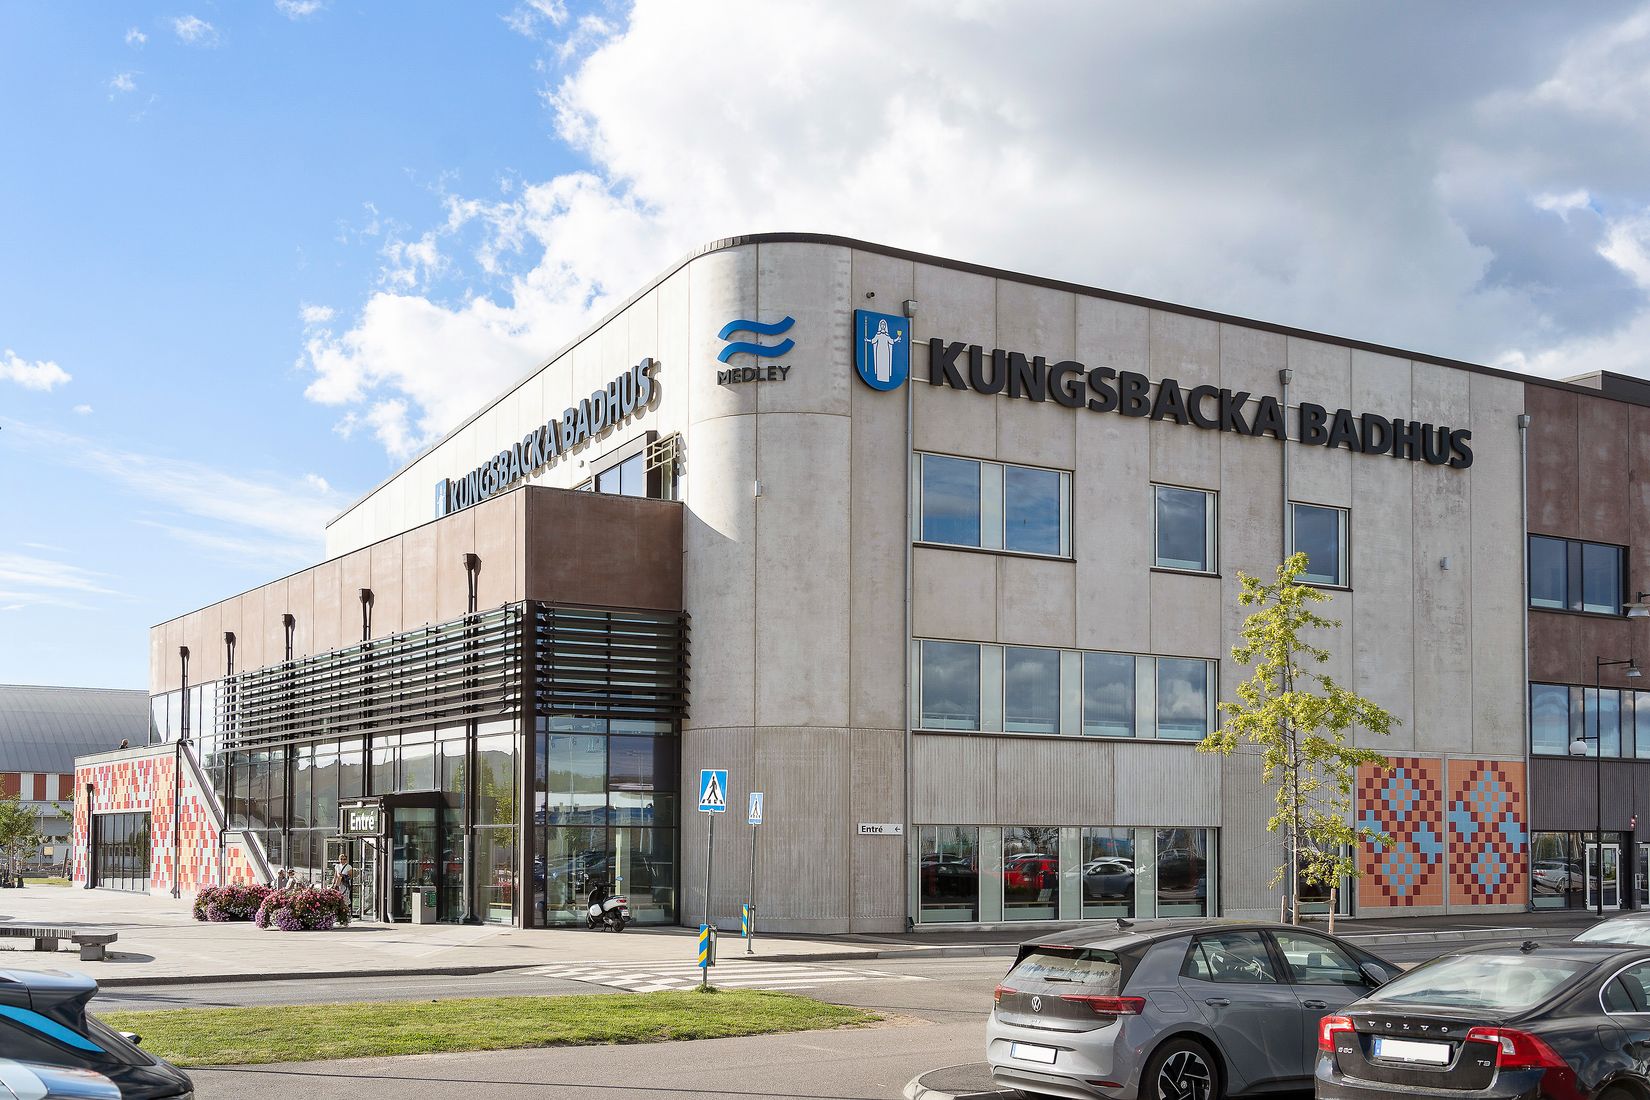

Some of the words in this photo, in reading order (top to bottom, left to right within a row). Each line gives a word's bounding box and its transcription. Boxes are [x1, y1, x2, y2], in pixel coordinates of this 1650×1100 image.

[717, 366, 791, 385] MEDLEY
[928, 337, 1288, 441] KUNGSBACKA
[1300, 402, 1474, 469] BADHUS
[450, 418, 561, 511] KUNGSBACKA
[563, 357, 654, 450] BADHUS
[350, 811, 375, 831] Entré
[861, 825, 883, 833] Entré
[1368, 1021, 1448, 1033] VOLVO
